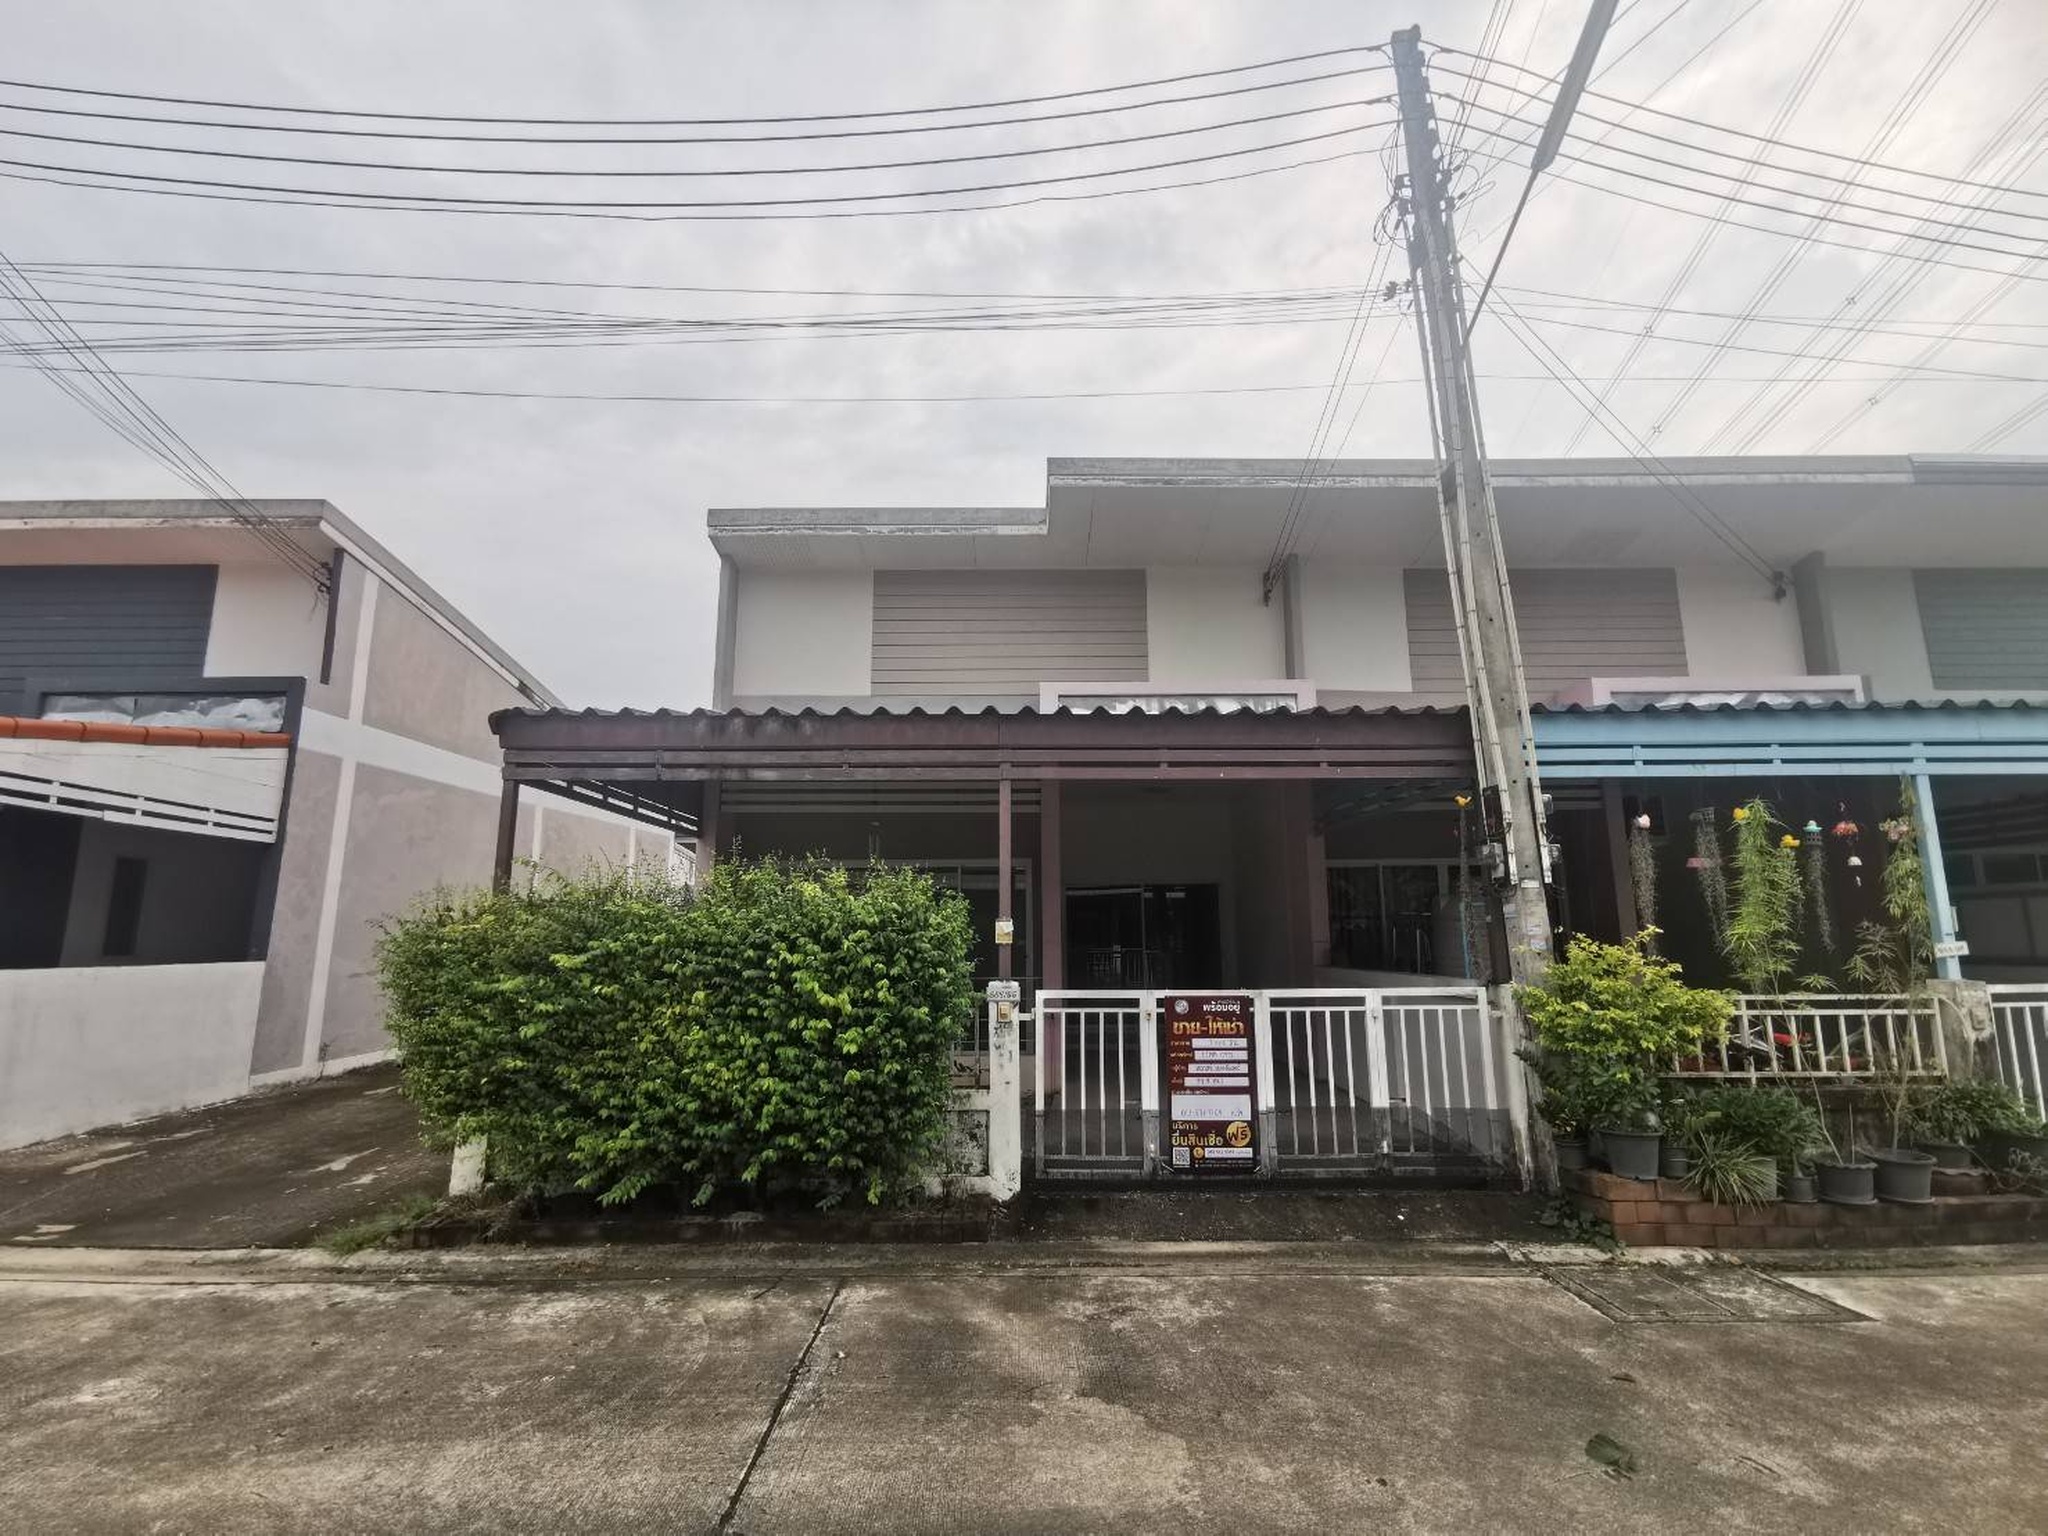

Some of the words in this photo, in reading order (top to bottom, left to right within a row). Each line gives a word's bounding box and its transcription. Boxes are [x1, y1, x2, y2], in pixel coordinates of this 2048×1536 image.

[1203, 1001, 1241, 1014] พร้อมอยู่
[1172, 1015, 1245, 1035] ขาย-ให้เช่า
[1171, 1130, 1224, 1146] ยื่นสินเชื่อ
[1228, 1122, 1248, 1142] ฟรี
